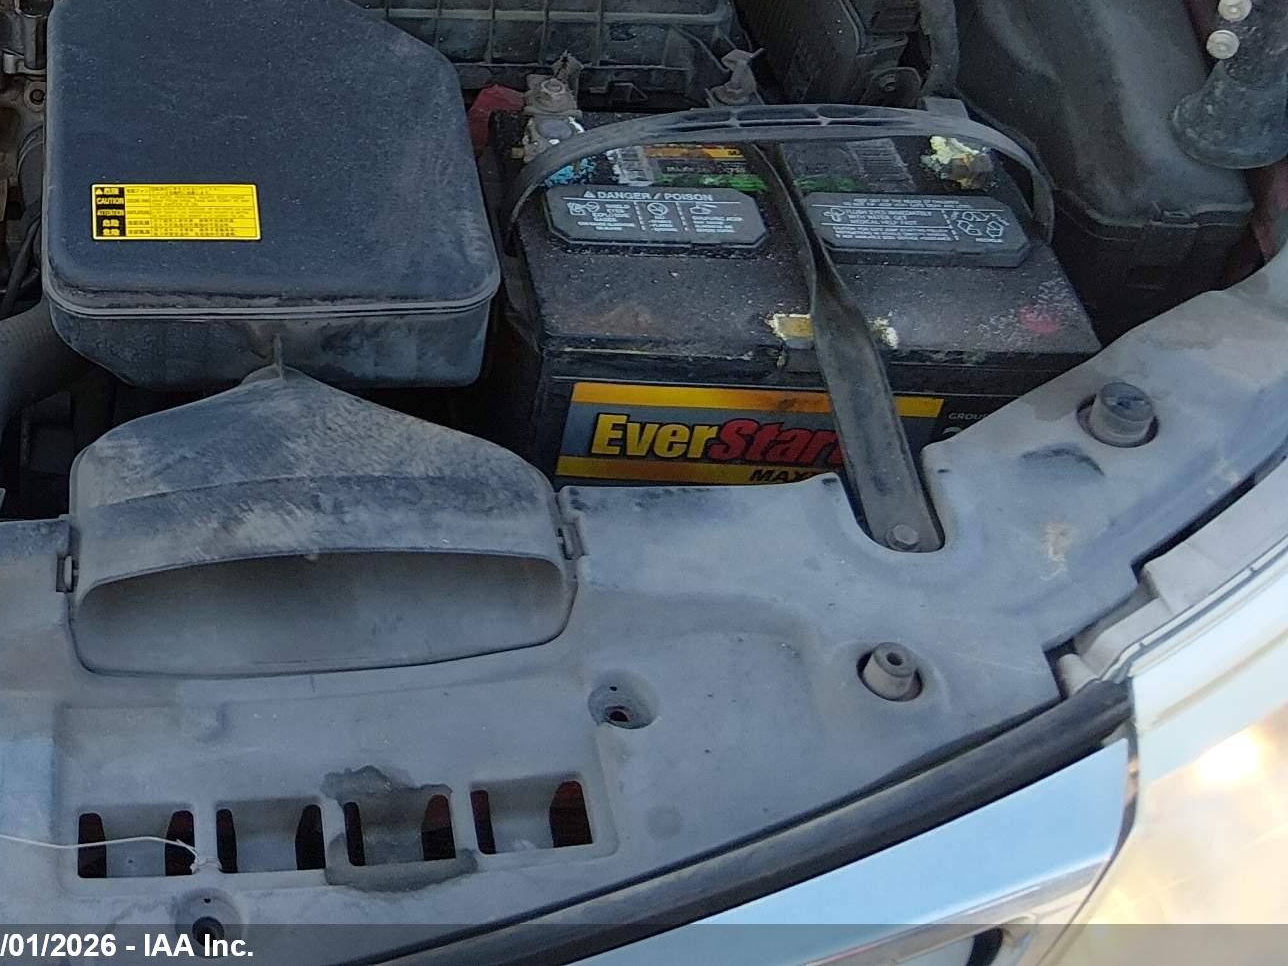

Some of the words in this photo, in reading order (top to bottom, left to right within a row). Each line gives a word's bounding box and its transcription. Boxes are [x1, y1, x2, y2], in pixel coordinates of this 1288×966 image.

[596, 191, 652, 200] DANGER
[652, 192, 661, 200] /
[664, 193, 714, 202] POISON
[96, 197, 124, 205] CAUTION
[948, 412, 985, 420] GROU
